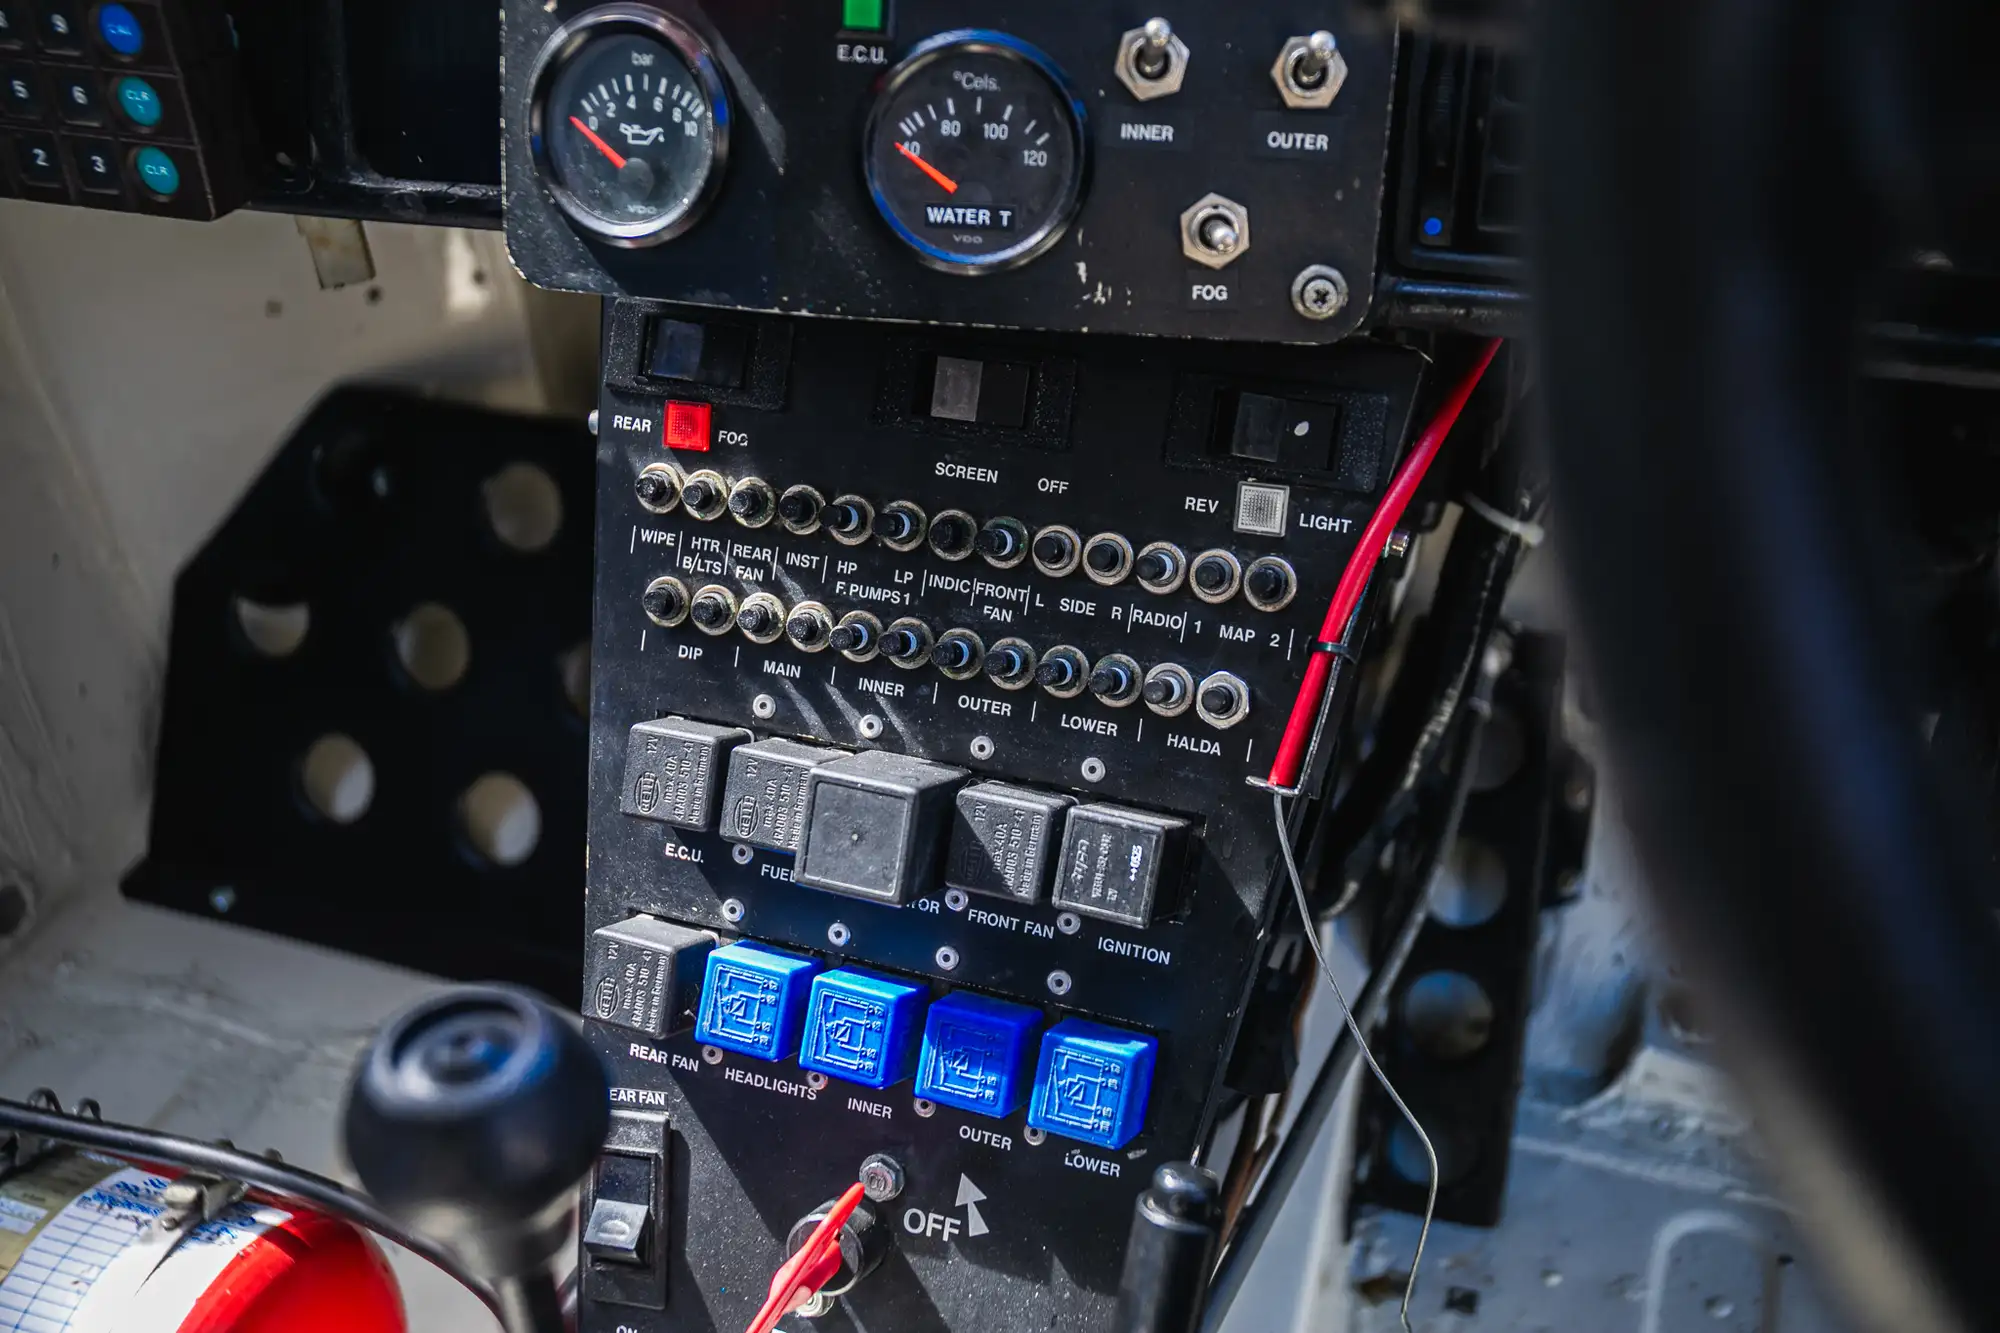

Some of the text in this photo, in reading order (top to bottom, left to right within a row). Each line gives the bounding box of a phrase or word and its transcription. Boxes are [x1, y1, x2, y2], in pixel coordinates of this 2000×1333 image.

[632, 51, 654, 66] bar
[837, 45, 888, 64] E.C.U.
[12, 80, 29, 98] 5
[72, 86, 88, 104] 6
[606, 102, 616, 118] 2
[626, 94, 636, 110] 4
[653, 97, 663, 112] 6
[588, 116, 598, 131] 0
[672, 107, 682, 123] 8
[684, 121, 698, 137] 10
[941, 120, 961, 137] 80
[984, 123, 1008, 140] 100
[1120, 123, 1174, 142] INNER
[1267, 131, 1329, 151] OUTER
[33, 149, 49, 166] 2
[91, 156, 106, 173] 3
[1023, 150, 1048, 167] 120
[926, 206, 1012, 228] WATER T
[953, 234, 983, 244] VDO
[1192, 285, 1228, 301] FOG
[613, 415, 652, 433] REAR
[935, 462, 999, 484] SCREEN
[1037, 477, 1070, 494] OFF
[1184, 496, 1352, 534] REV LIGHT
[640, 528, 676, 547] WIPE
[691, 536, 721, 553] HTR
[732, 543, 772, 562] REAR
[786, 552, 820, 569] INST
[682, 552, 722, 575] B/LTS
[837, 560, 914, 585] HP LP
[735, 565, 764, 582] FAN
[928, 574, 972, 593] INDIC
[975, 582, 1027, 602] FRONT
[983, 605, 1013, 623] FAN
[1036, 594, 1123, 621] L SIDE R
[1132, 610, 1183, 630] RADIO
[1194, 620, 1281, 648] 1 MAP 2
[678, 645, 703, 660] DIP
[763, 660, 801, 679] MAIN
[858, 677, 905, 698] INNER
[957, 694, 1013, 717] OUTER
[1061, 713, 1118, 737] LOWER
[647, 736, 659, 754] 12V
[1167, 733, 1222, 757] HALDA
[747, 759, 758, 777] 12V
[975, 802, 987, 821] 12V
[1025, 812, 1044, 856] Germany
[665, 842, 704, 863] E.C.U.
[968, 909, 1055, 939] FRONT FAN
[608, 942, 619, 960] 12V
[1098, 936, 1171, 965] IGNITION
[630, 1043, 699, 1072] REAR FAN
[725, 1067, 818, 1100] HEADLIGHTS
[610, 1089, 665, 1106] EAR FAN
[847, 1098, 893, 1119] INNER
[959, 1126, 1012, 1151] OUTER
[1064, 1153, 1121, 1178] LOWER
[903, 1207, 962, 1242] OFF
